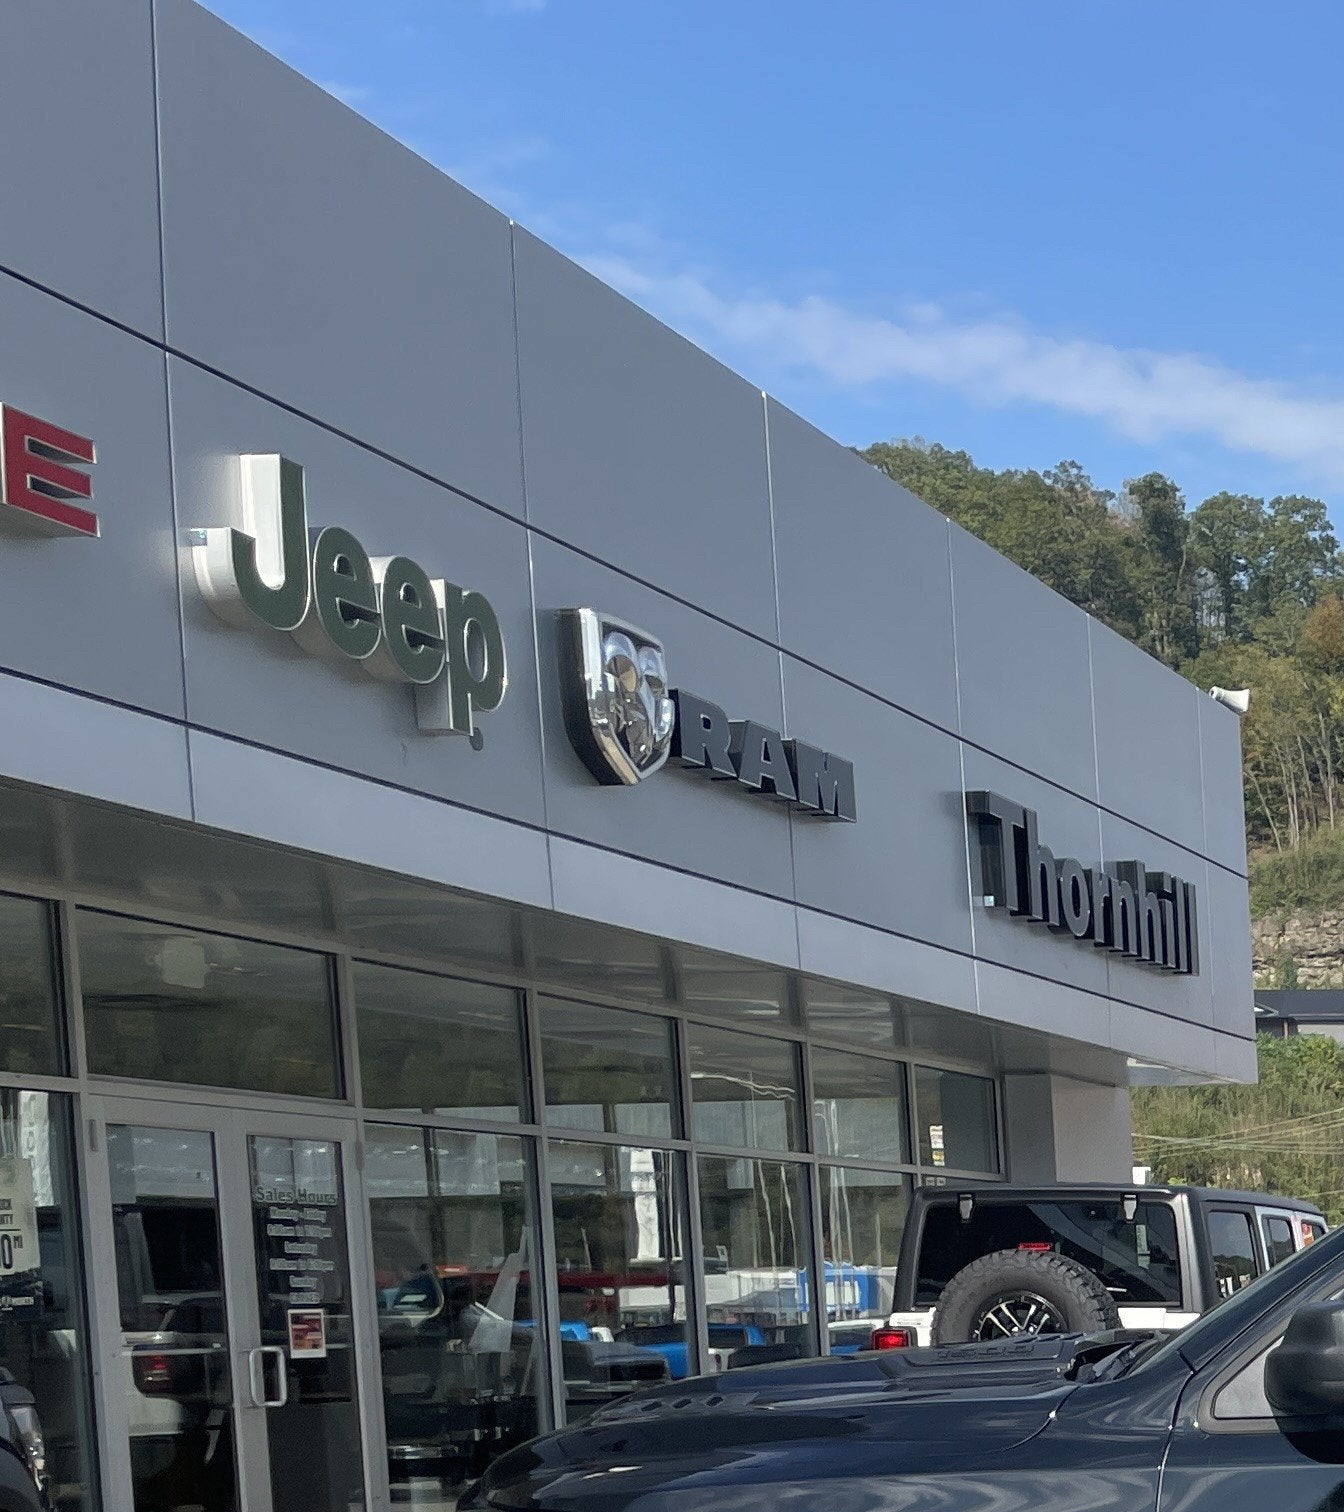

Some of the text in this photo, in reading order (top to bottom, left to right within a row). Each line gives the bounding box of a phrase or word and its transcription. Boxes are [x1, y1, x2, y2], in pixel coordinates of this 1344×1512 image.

[0, 402, 101, 538] E
[195, 454, 508, 737] Jeep
[671, 689, 857, 823] RAM
[967, 790, 1198, 976] Thornhill
[256, 1185, 337, 1205] Sales Hours
